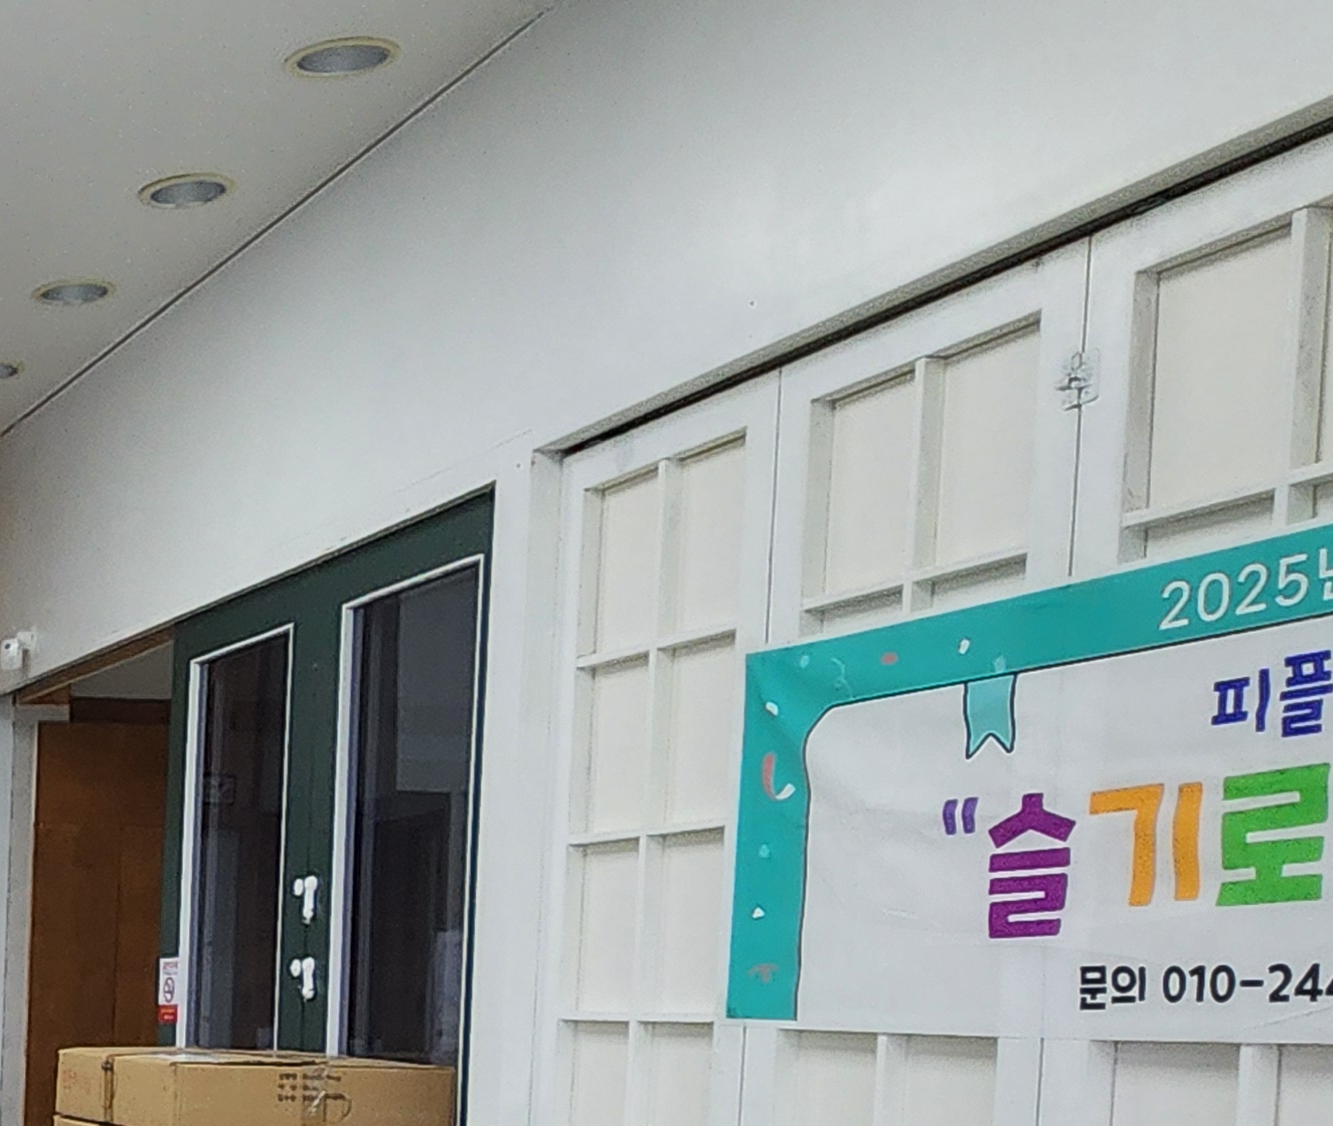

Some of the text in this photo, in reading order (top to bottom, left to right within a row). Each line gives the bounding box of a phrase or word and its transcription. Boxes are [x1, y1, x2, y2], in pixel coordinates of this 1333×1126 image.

[1211, 650, 1333, 738] 피플
[1080, 963, 1333, 1010] 문의 010-24
